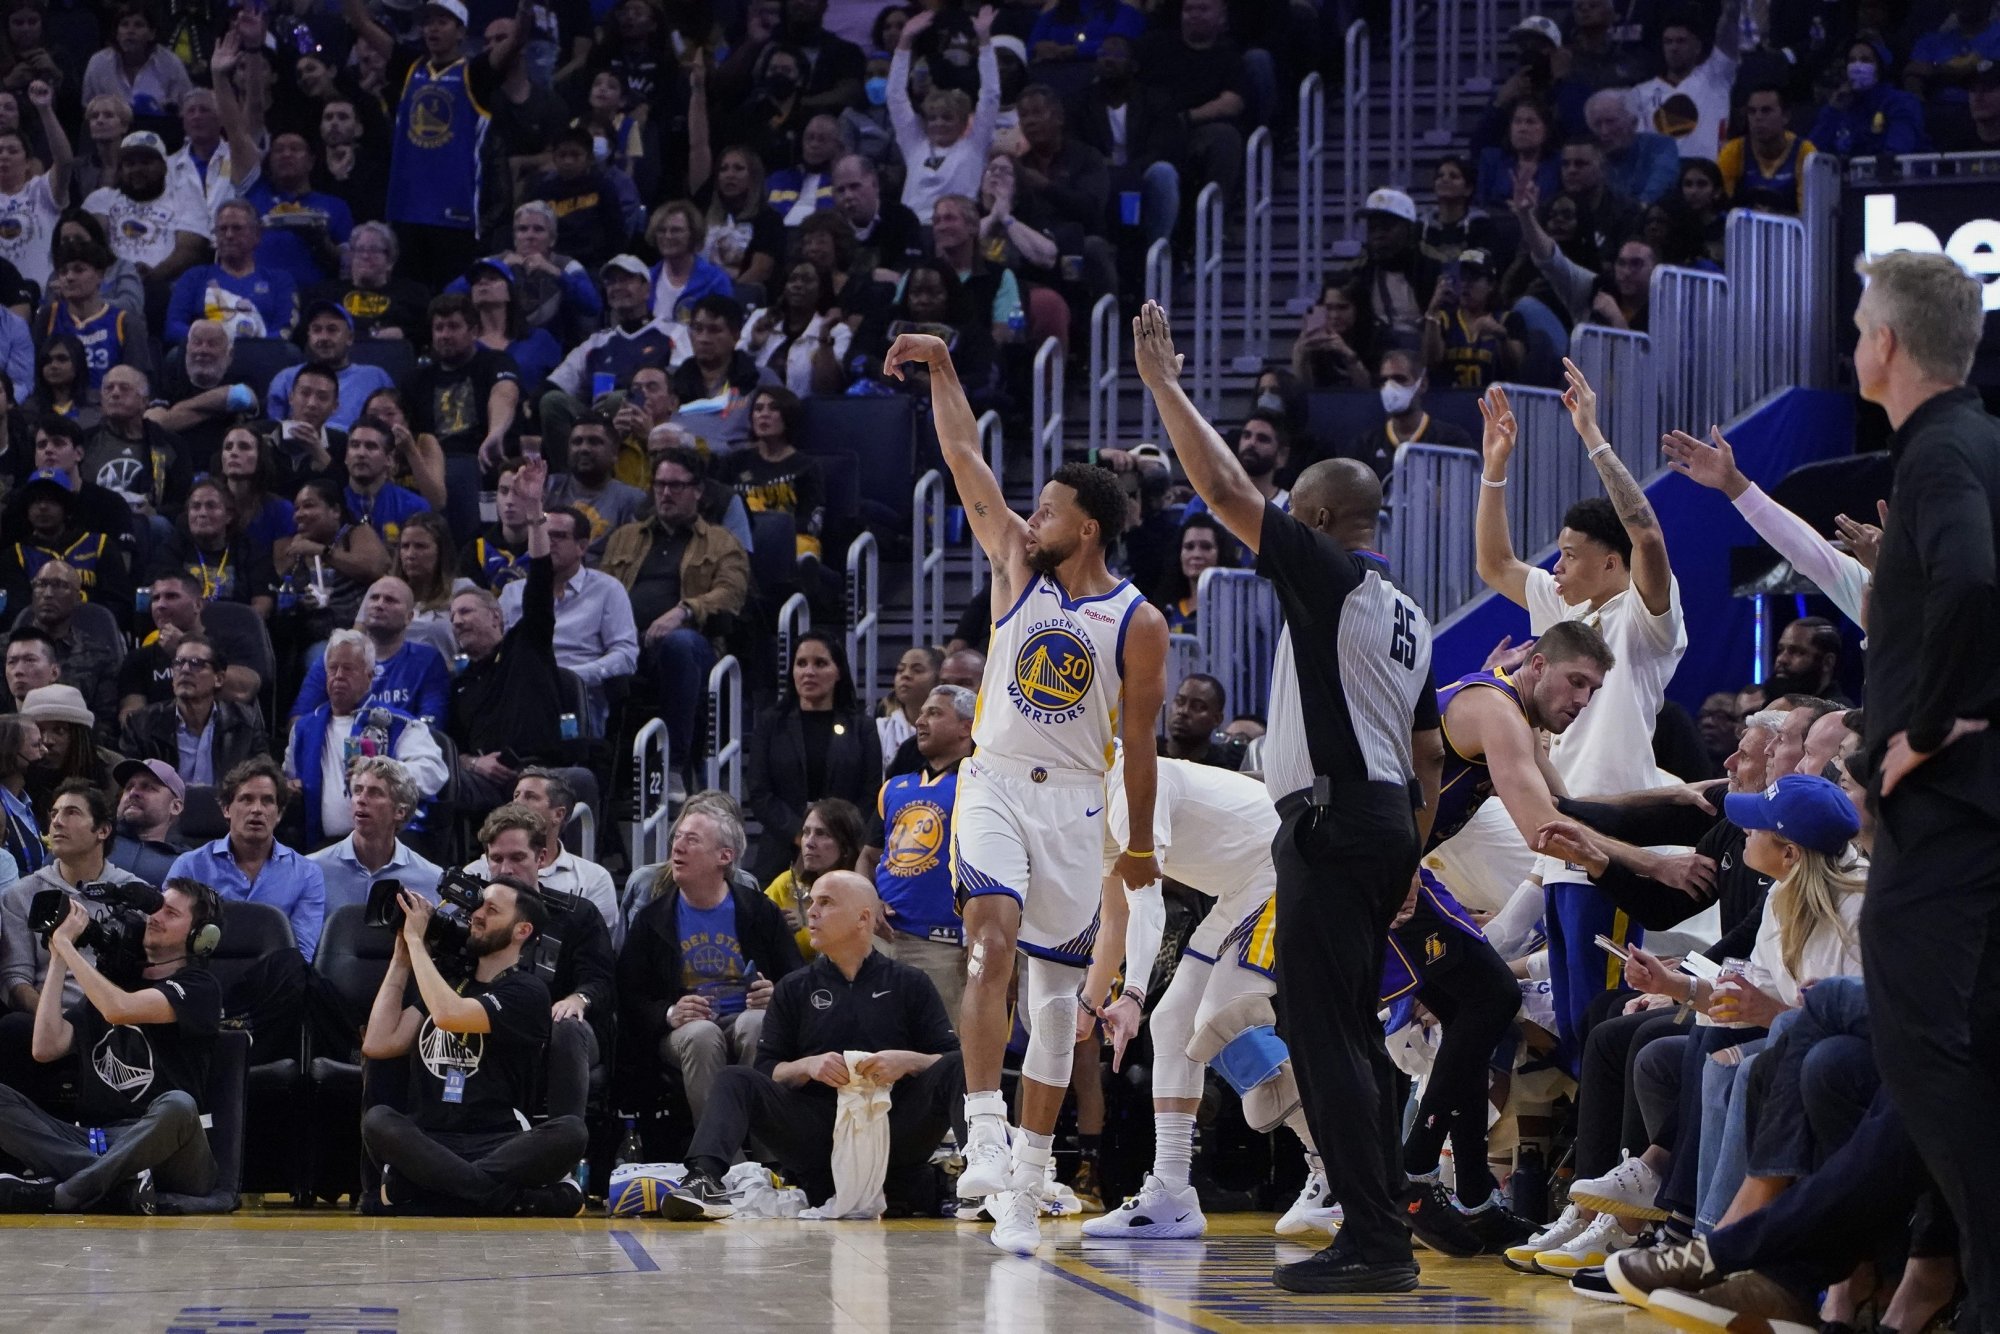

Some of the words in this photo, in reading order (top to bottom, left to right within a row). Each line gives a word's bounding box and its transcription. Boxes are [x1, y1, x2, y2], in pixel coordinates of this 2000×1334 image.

[1084, 608, 1116, 625] Rakuten
[1027, 618, 1073, 635] GOLDEN
[1075, 628, 1097, 659] STATE
[1390, 599, 1416, 672] 25
[1059, 653, 1087, 680] 30
[1007, 681, 1086, 724] WARRIORS
[650, 771, 661, 794] 22
[925, 801, 948, 822] STATE
[913, 818, 933, 835] 30
[680, 931, 709, 953] DEN
[715, 932, 741, 954] STA
